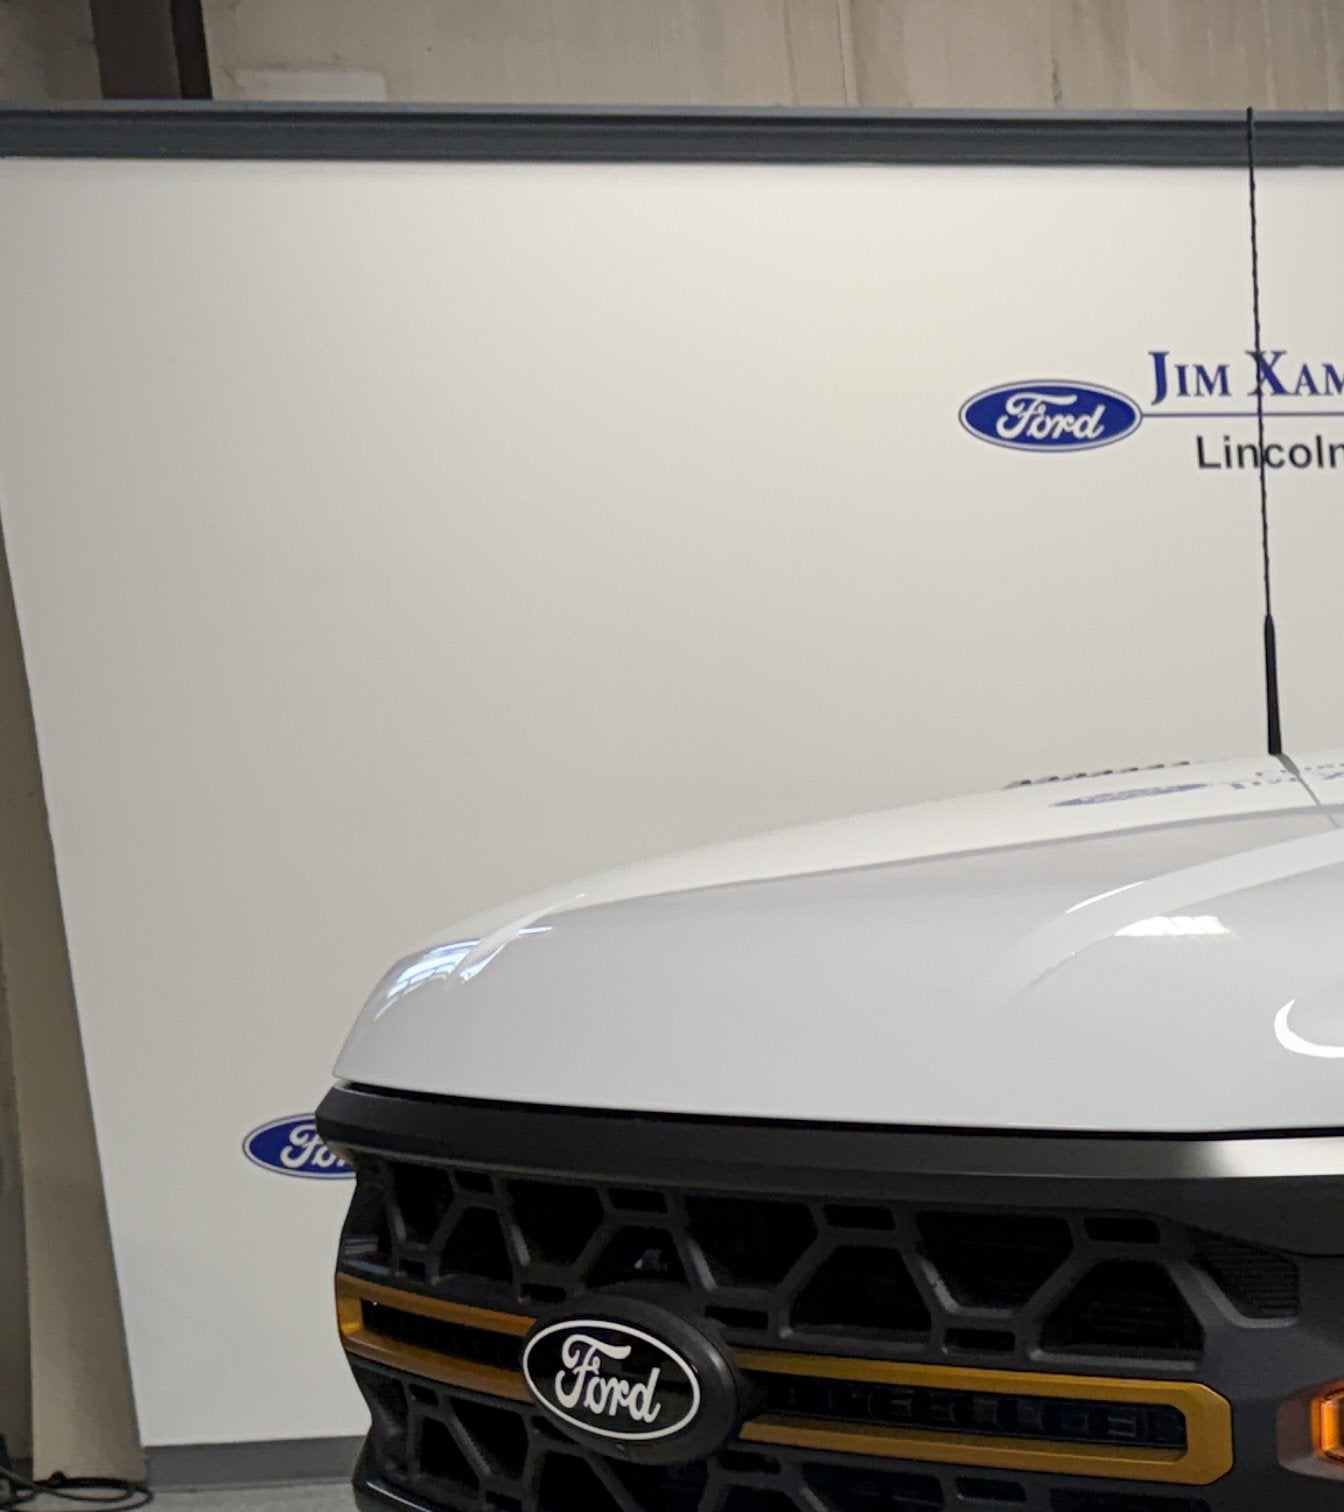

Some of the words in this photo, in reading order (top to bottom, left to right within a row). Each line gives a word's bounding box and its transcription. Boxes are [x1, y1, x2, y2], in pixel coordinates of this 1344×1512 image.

[1148, 350, 1229, 405] JIM
[996, 392, 1105, 440] Ford
[280, 1124, 344, 1168] Fo
[555, 1334, 661, 1423] Ford
